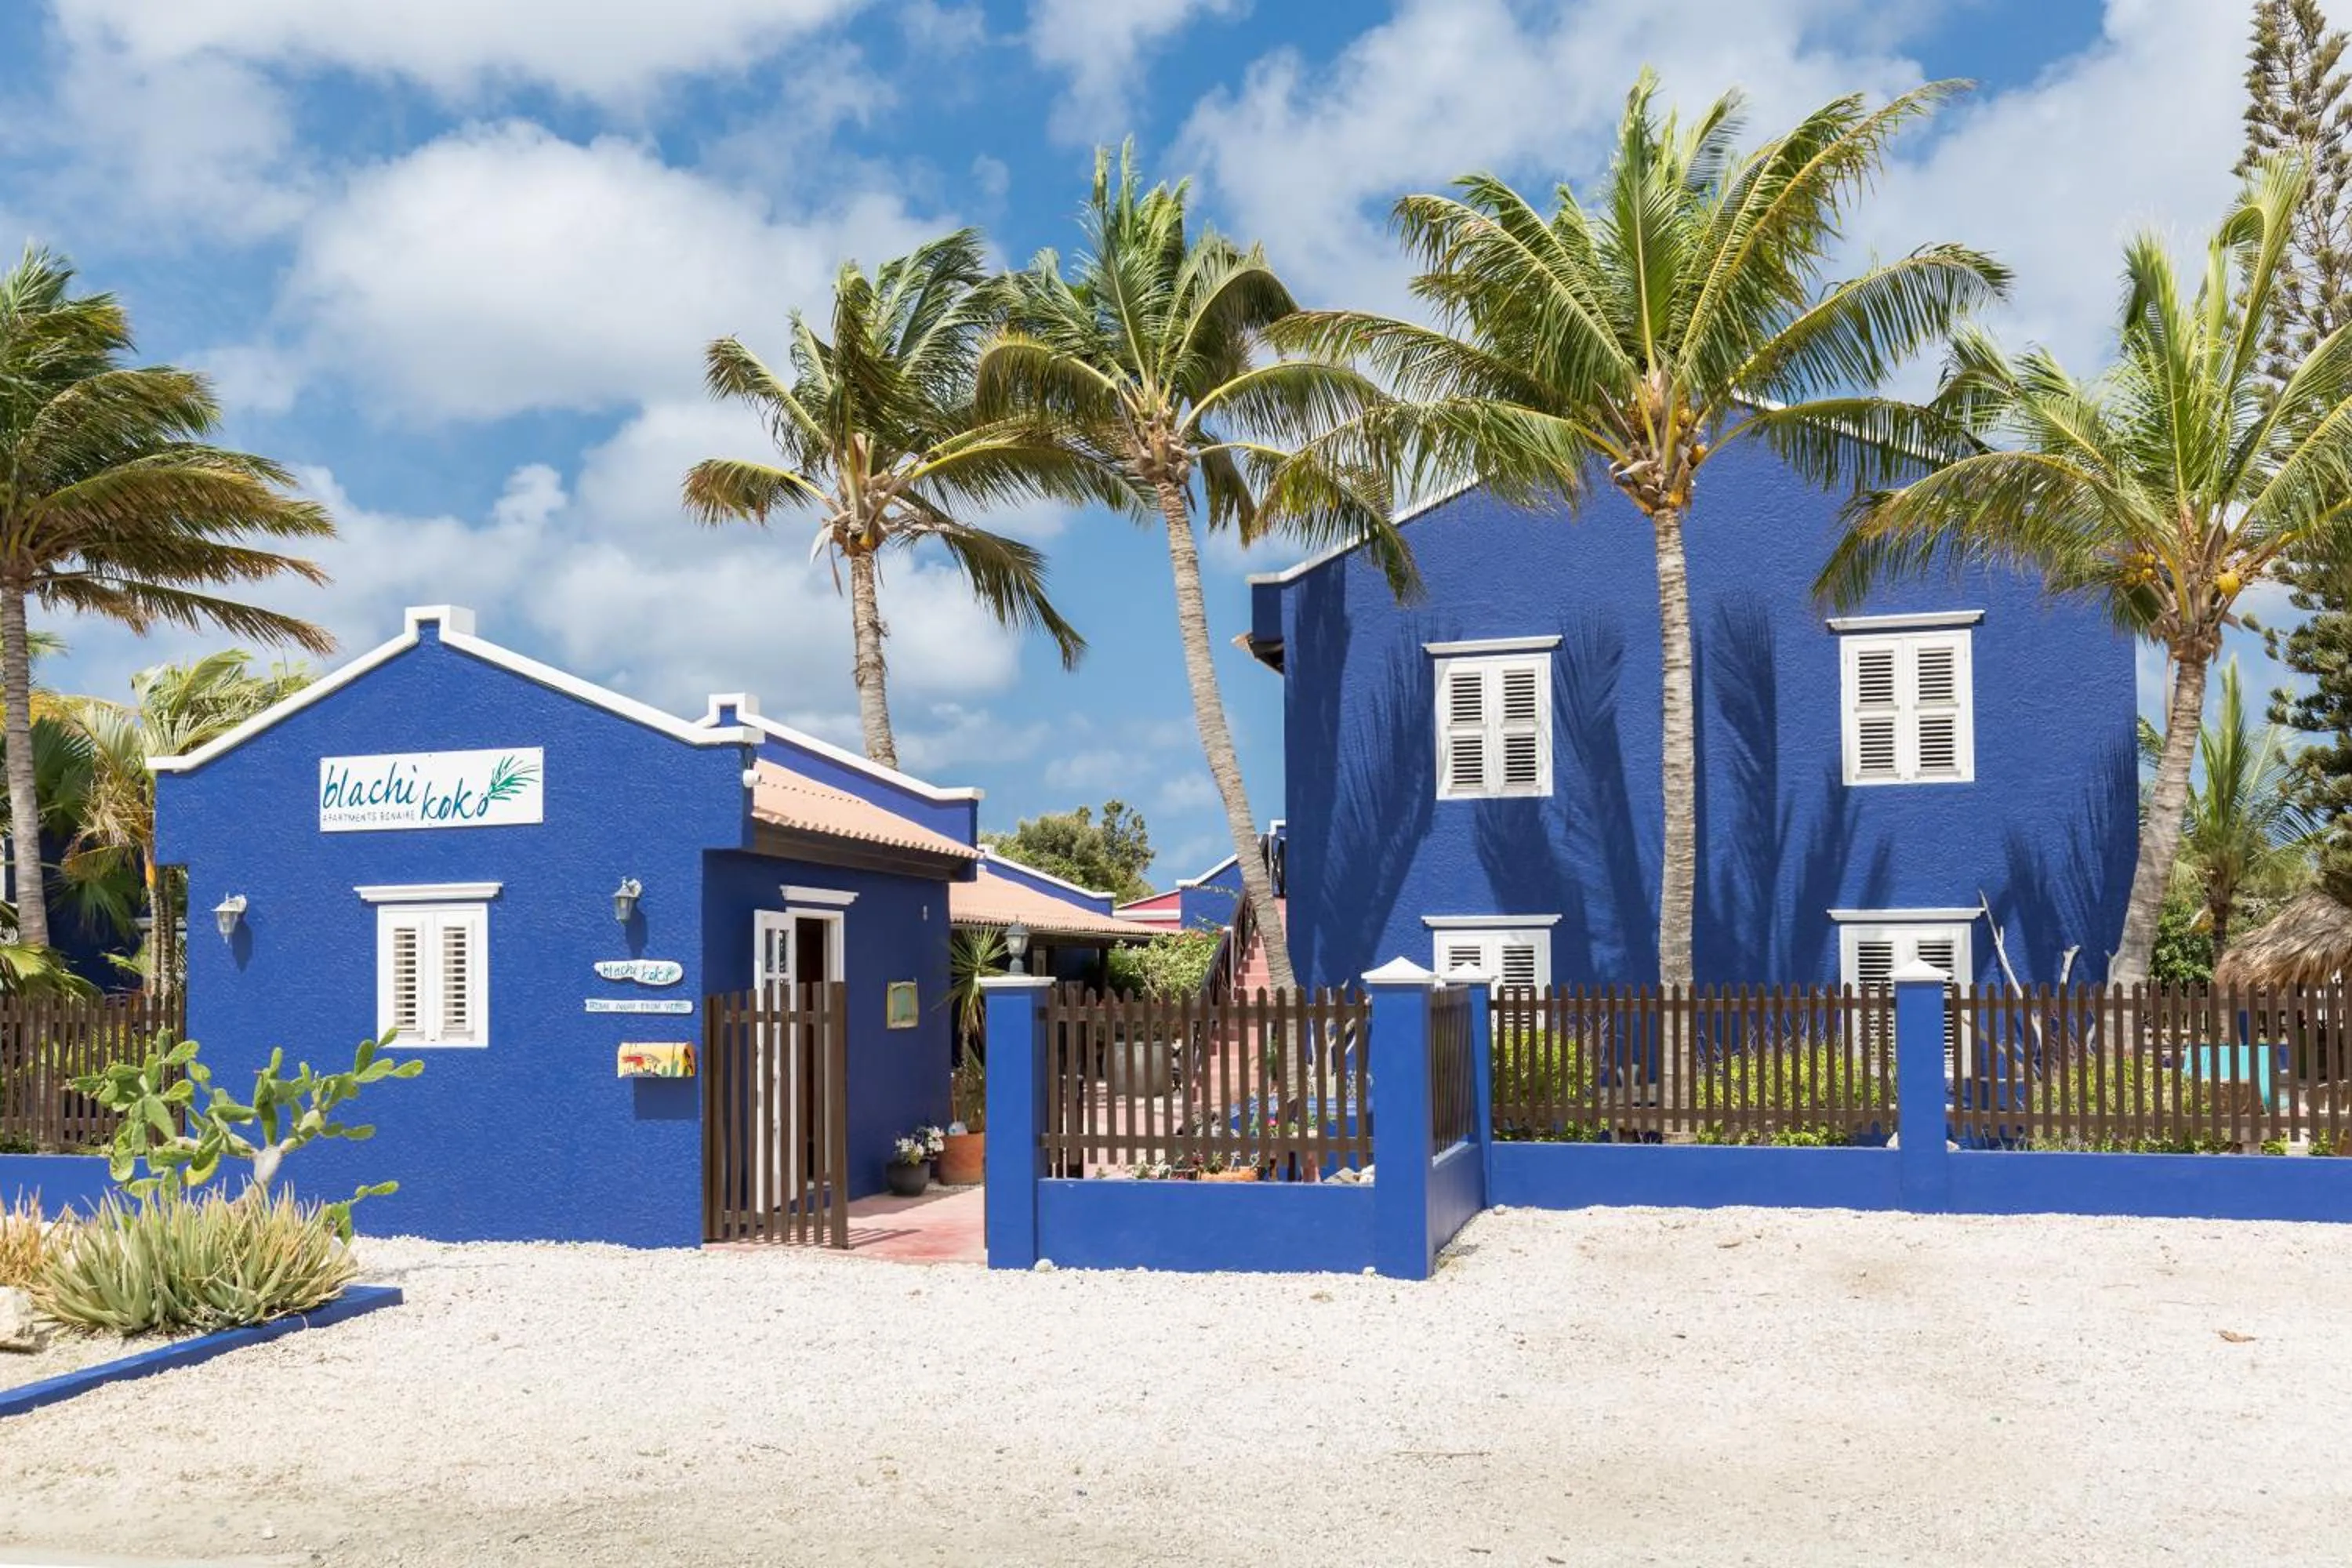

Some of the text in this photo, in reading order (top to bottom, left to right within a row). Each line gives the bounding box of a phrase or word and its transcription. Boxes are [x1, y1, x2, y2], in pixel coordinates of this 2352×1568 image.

[322, 762, 417, 809] blachi
[322, 810, 415, 822] APARTMENTS BONAIRE
